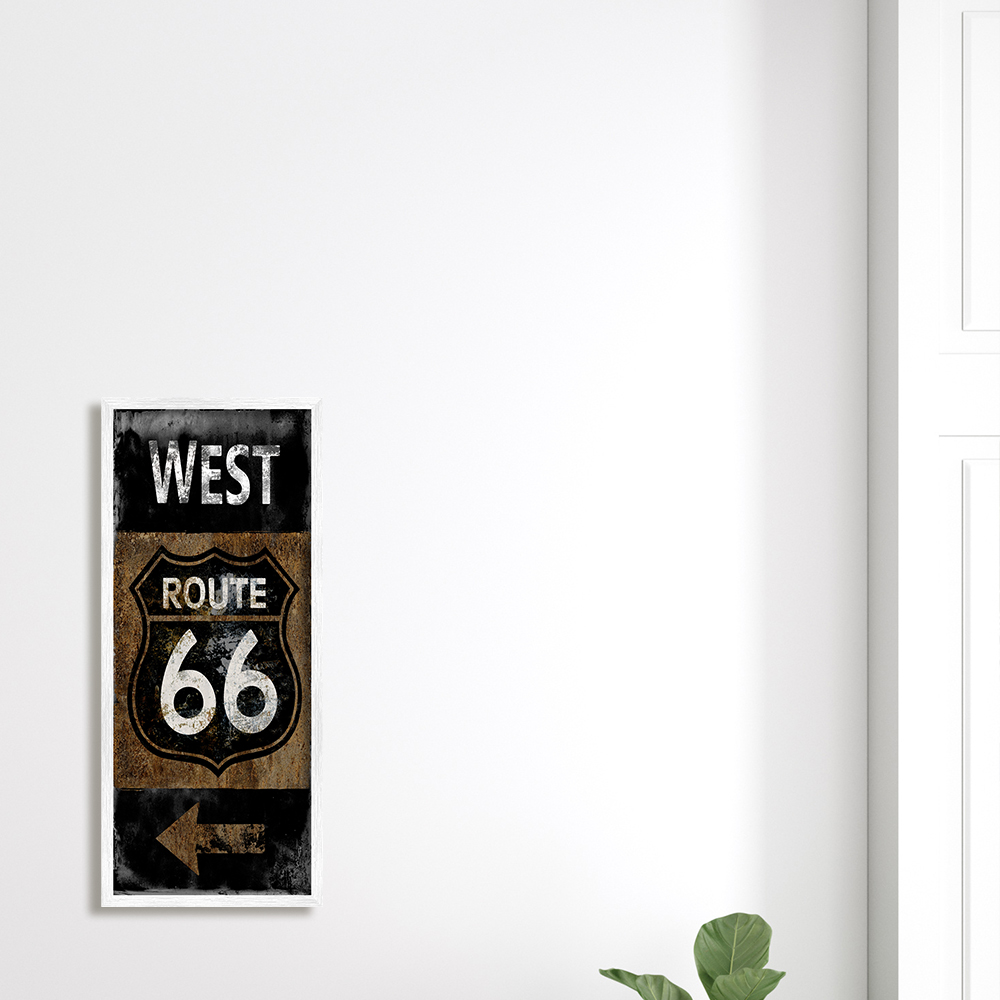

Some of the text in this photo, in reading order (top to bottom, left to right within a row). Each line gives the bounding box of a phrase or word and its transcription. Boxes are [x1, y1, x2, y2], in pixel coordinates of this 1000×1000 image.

[149, 440, 281, 505] WEST
[162, 576, 267, 610] ROUTE
[160, 629, 278, 735] 66
